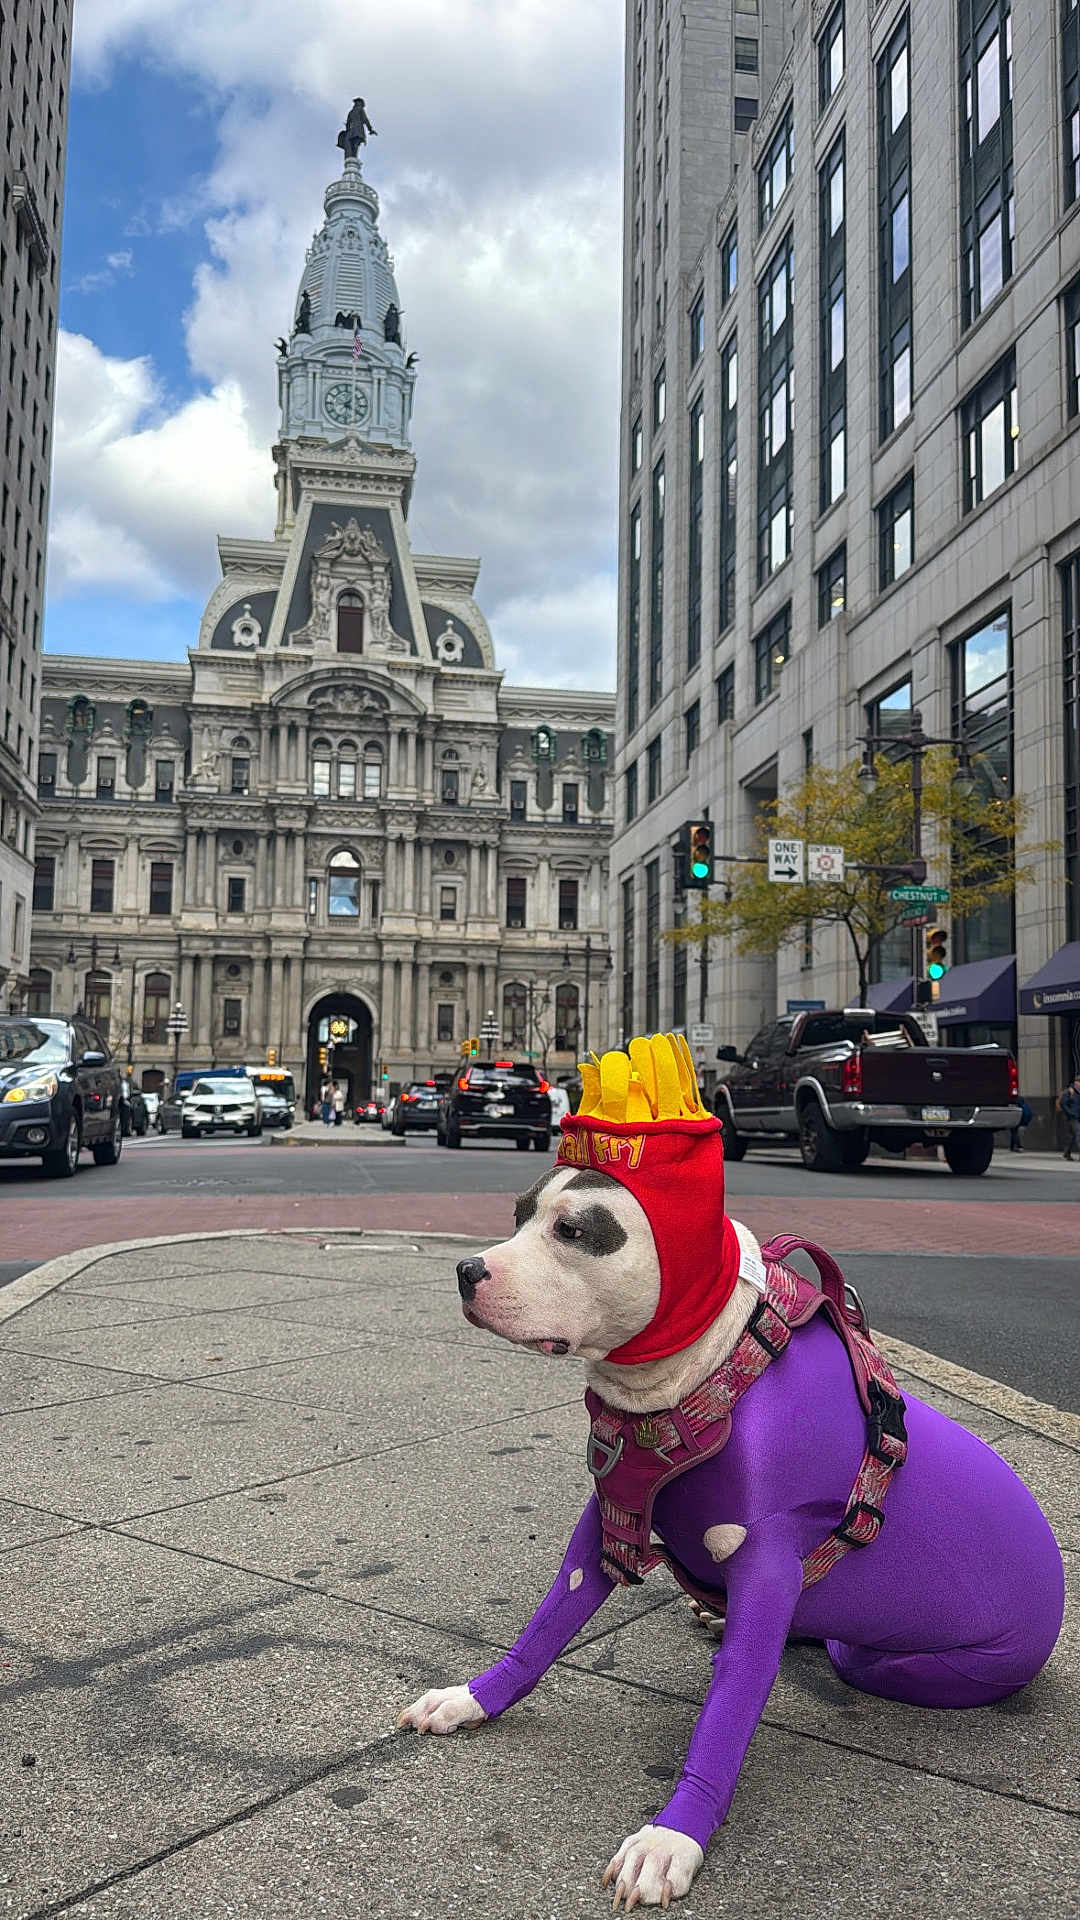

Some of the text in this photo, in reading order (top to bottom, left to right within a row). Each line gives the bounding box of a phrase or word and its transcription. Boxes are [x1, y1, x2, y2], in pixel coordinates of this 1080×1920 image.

[775, 842, 798, 854] ONE
[774, 854, 798, 865] WAY
[892, 890, 938, 901] CHESTNUT
[1043, 989, 1073, 1004] insomnia
[592, 1132, 646, 1169] Fry
